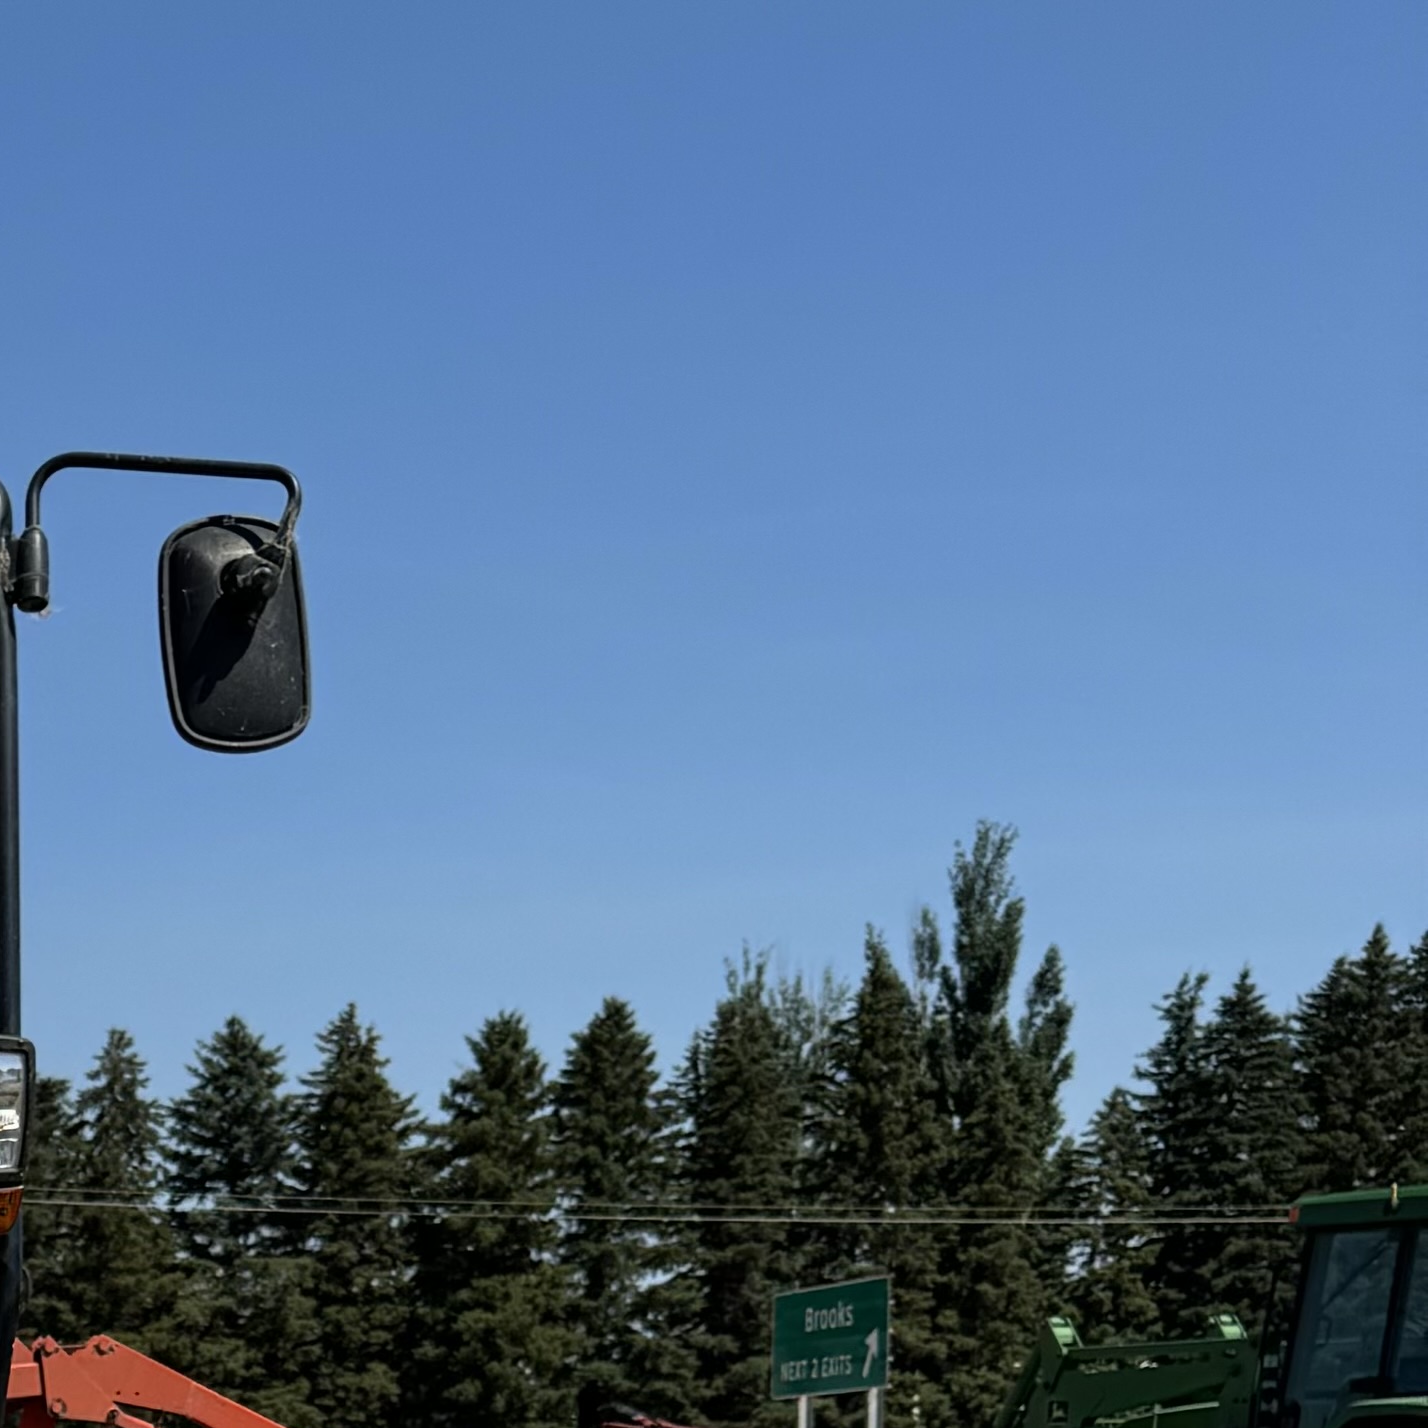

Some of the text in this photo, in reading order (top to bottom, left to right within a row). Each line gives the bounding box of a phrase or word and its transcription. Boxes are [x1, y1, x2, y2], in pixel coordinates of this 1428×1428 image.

[805, 1301, 853, 1332] Brooks
[780, 1354, 853, 1381] NEXT 2 EXITS
